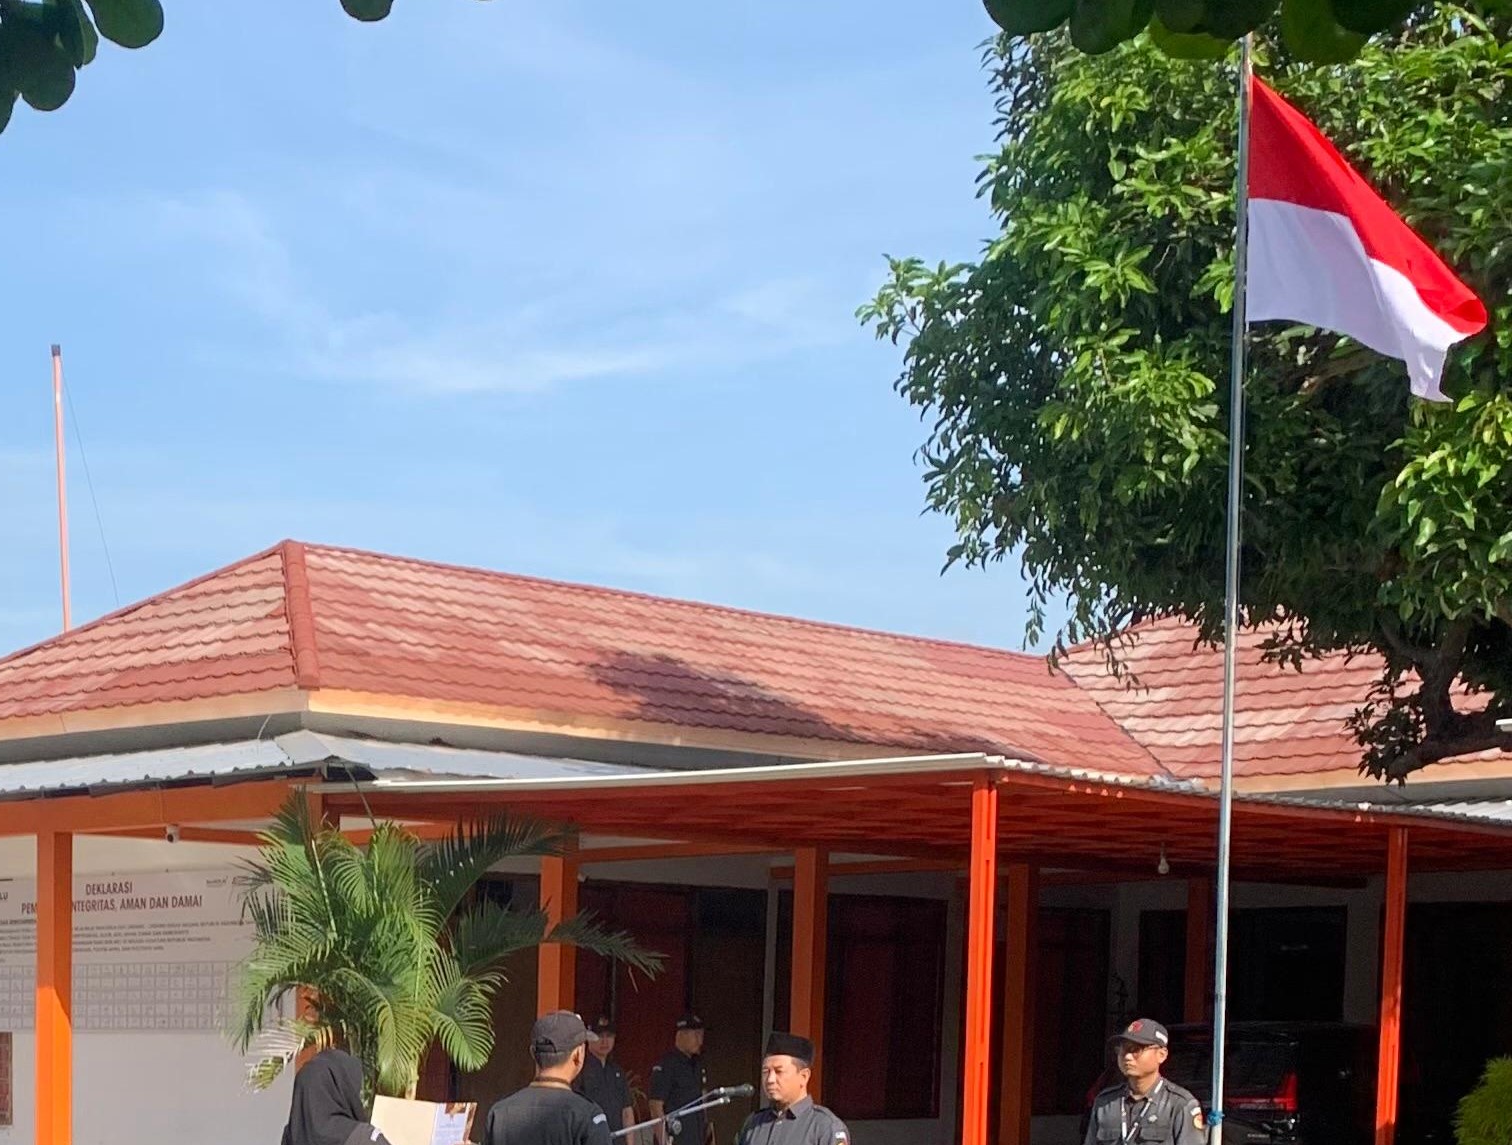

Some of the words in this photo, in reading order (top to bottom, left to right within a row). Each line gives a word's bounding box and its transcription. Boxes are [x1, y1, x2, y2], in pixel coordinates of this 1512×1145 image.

[86, 881, 133, 895] DEKLARASI
[120, 898, 146, 910] AMAN
[149, 897, 169, 909] DAN
[172, 895, 203, 908] DAMAI
